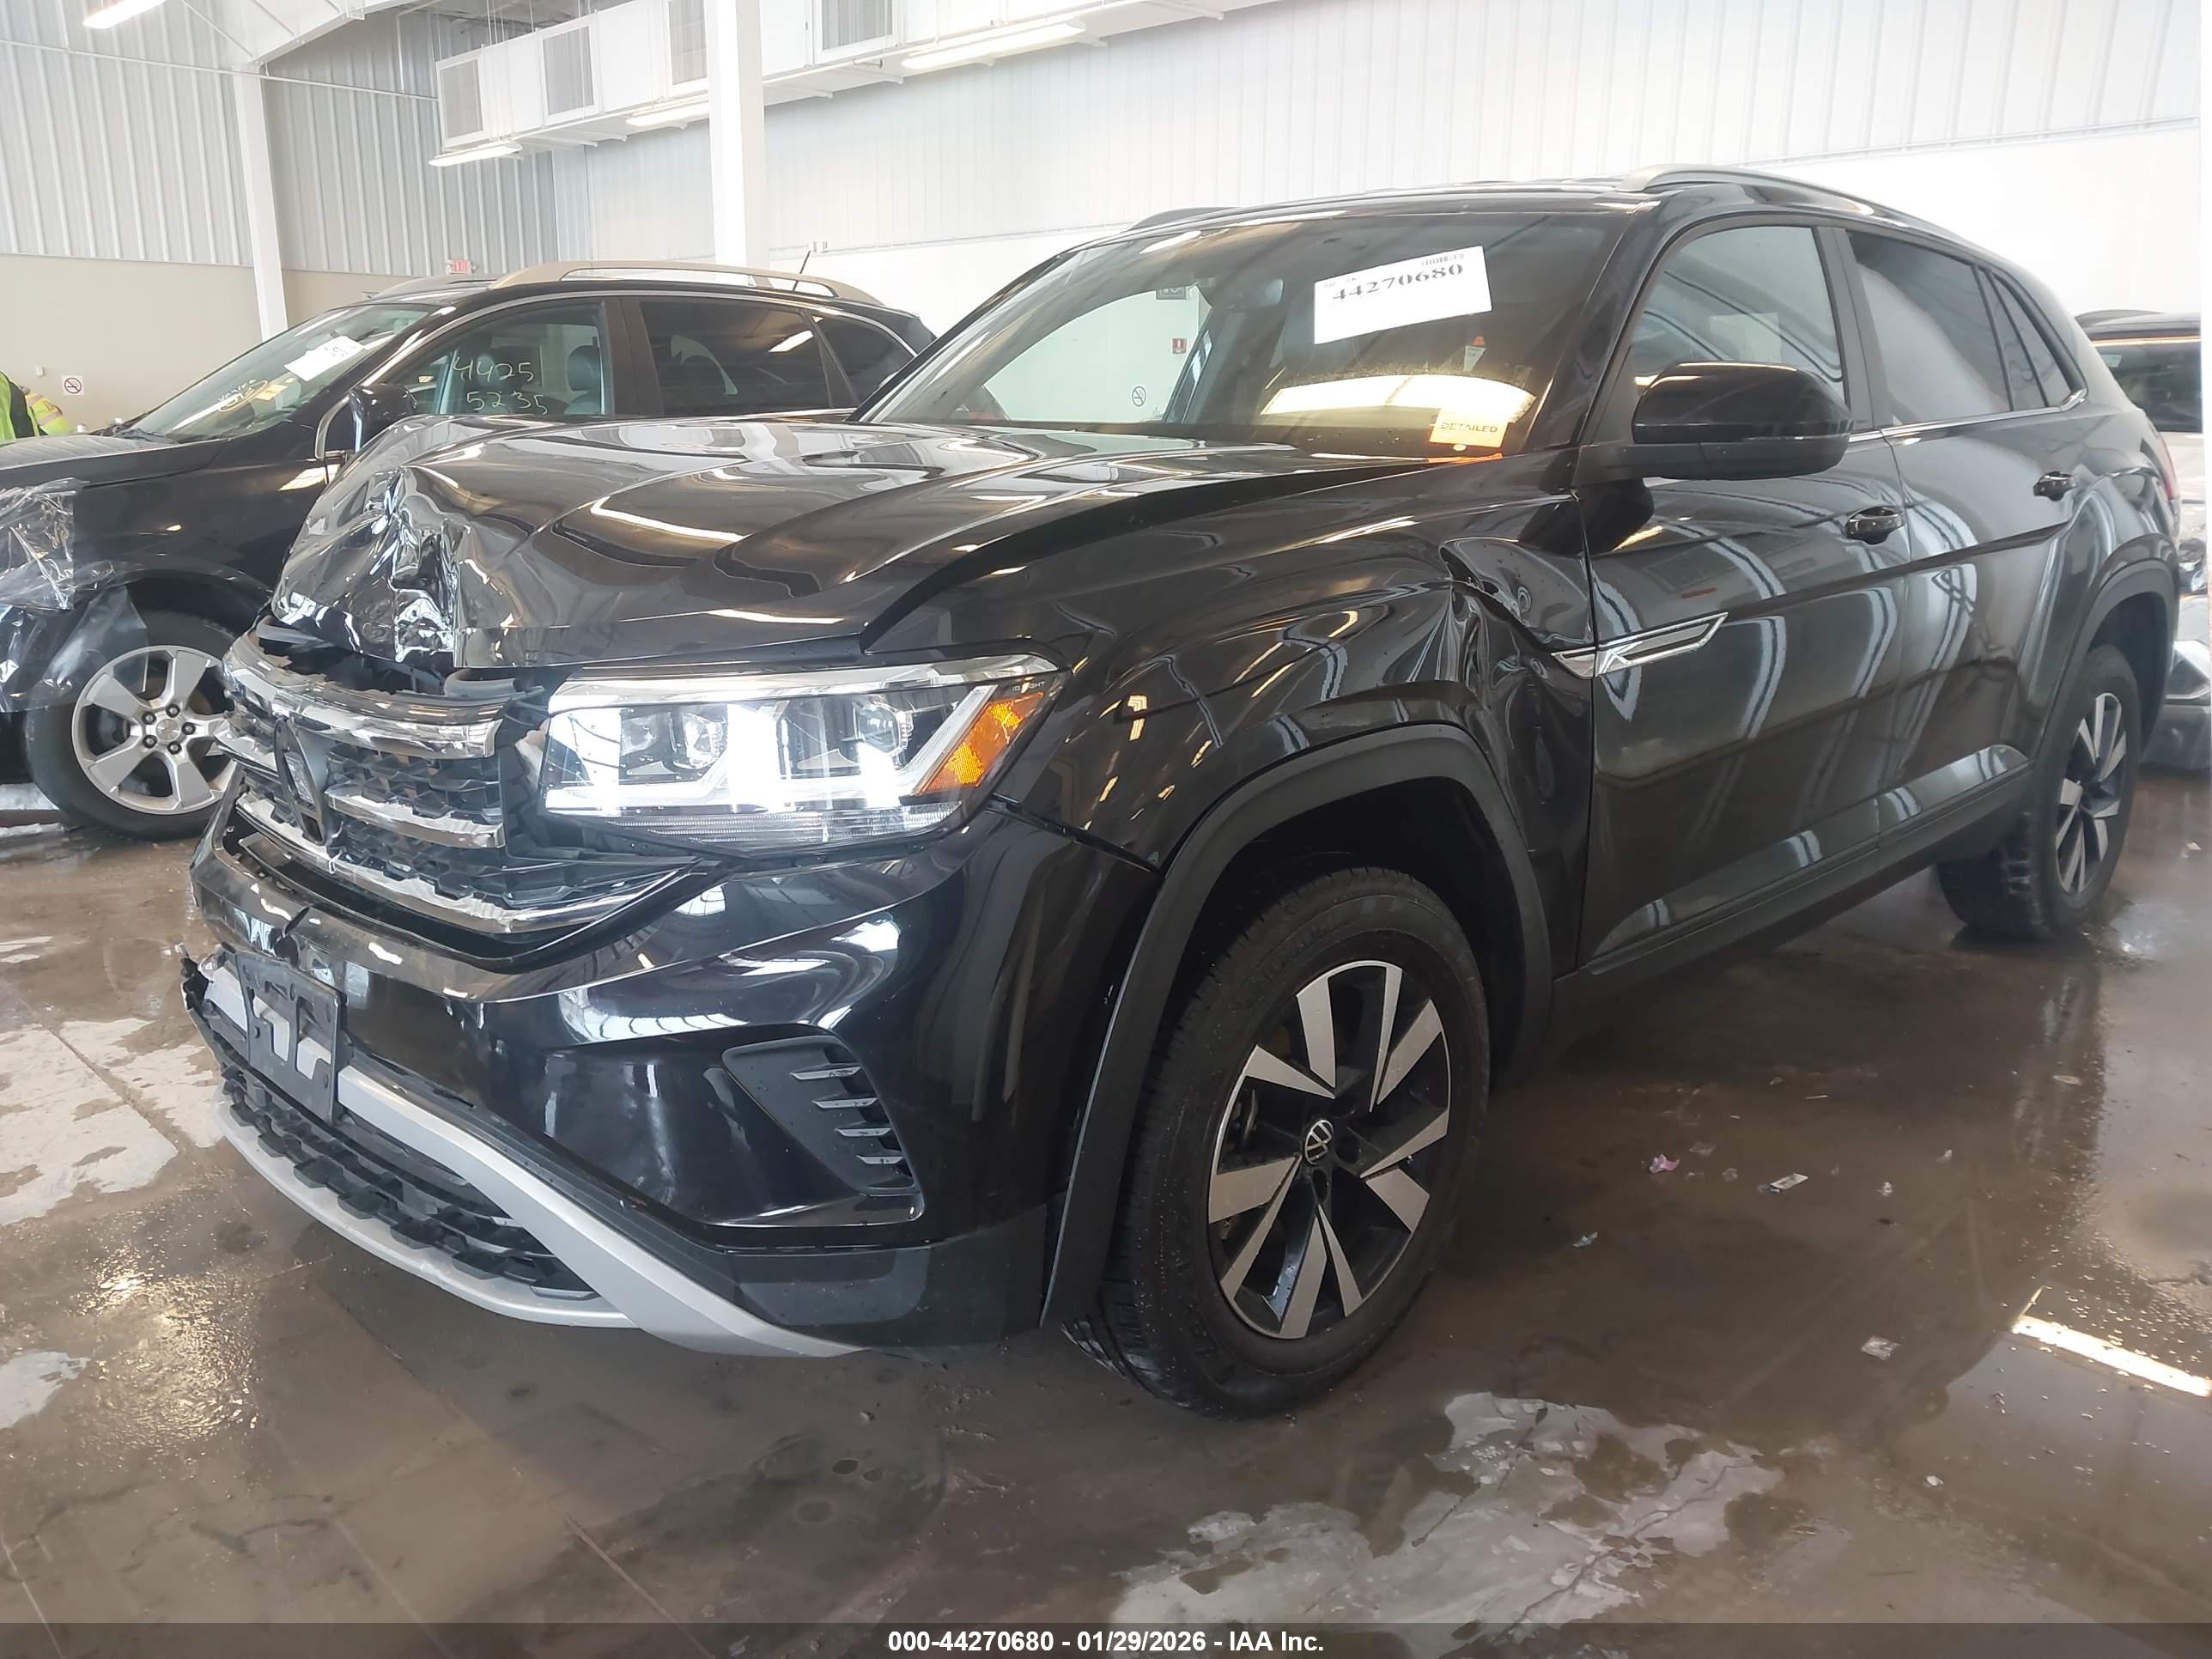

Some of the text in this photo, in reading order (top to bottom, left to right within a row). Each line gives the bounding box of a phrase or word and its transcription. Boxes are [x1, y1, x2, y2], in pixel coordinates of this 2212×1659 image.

[1332, 264, 1464, 301] 44270680
[453, 356, 534, 382] 4425
[466, 391, 548, 416] 5235
[1441, 422, 1498, 434] DETAILED
